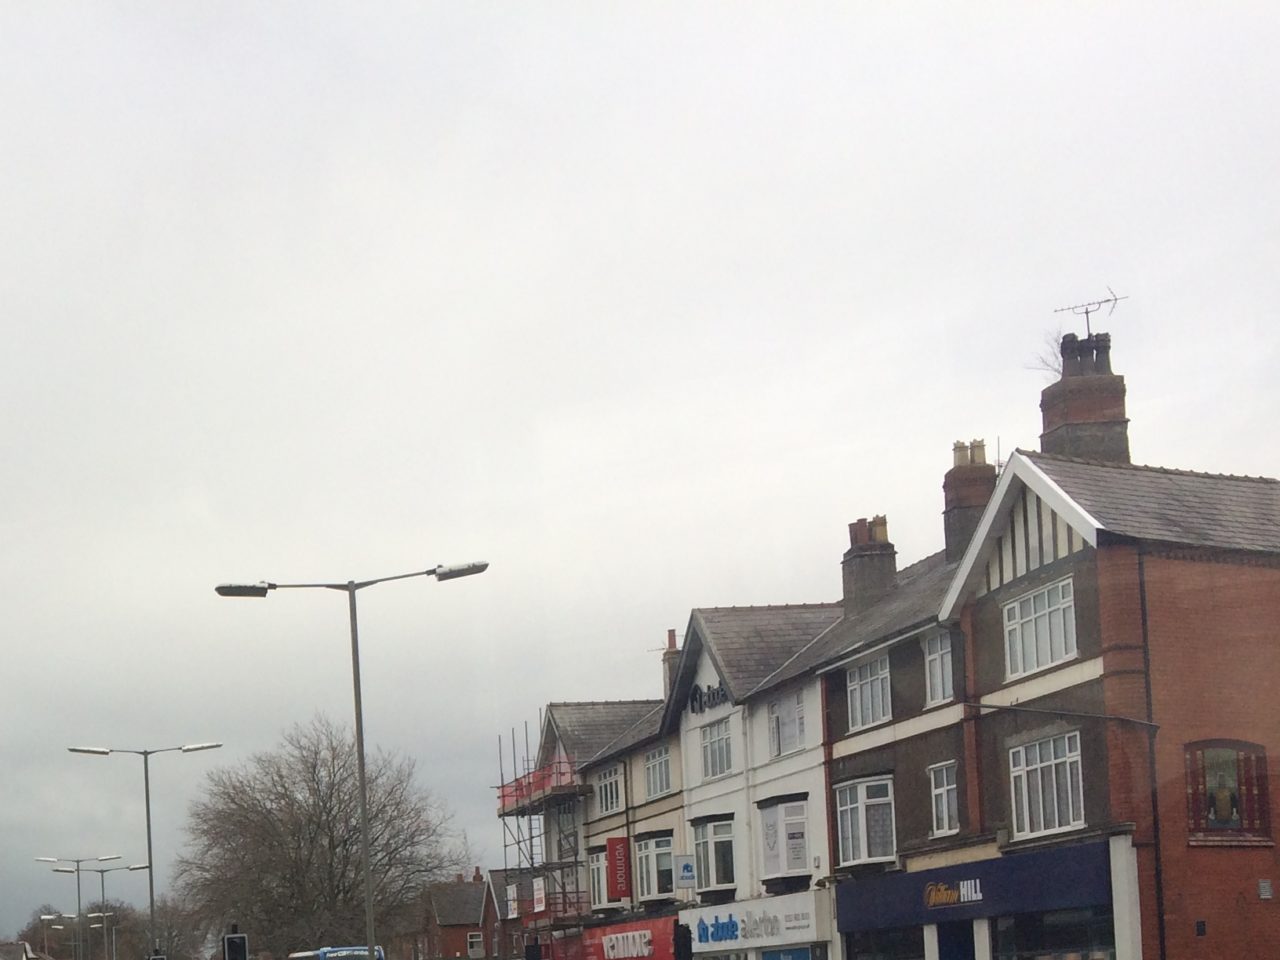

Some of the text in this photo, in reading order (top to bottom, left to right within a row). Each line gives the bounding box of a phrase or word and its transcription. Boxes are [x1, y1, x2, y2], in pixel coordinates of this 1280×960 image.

[617, 843, 627, 891] venmore
[960, 878, 983, 902] HILL
[602, 929, 653, 960] venmore
